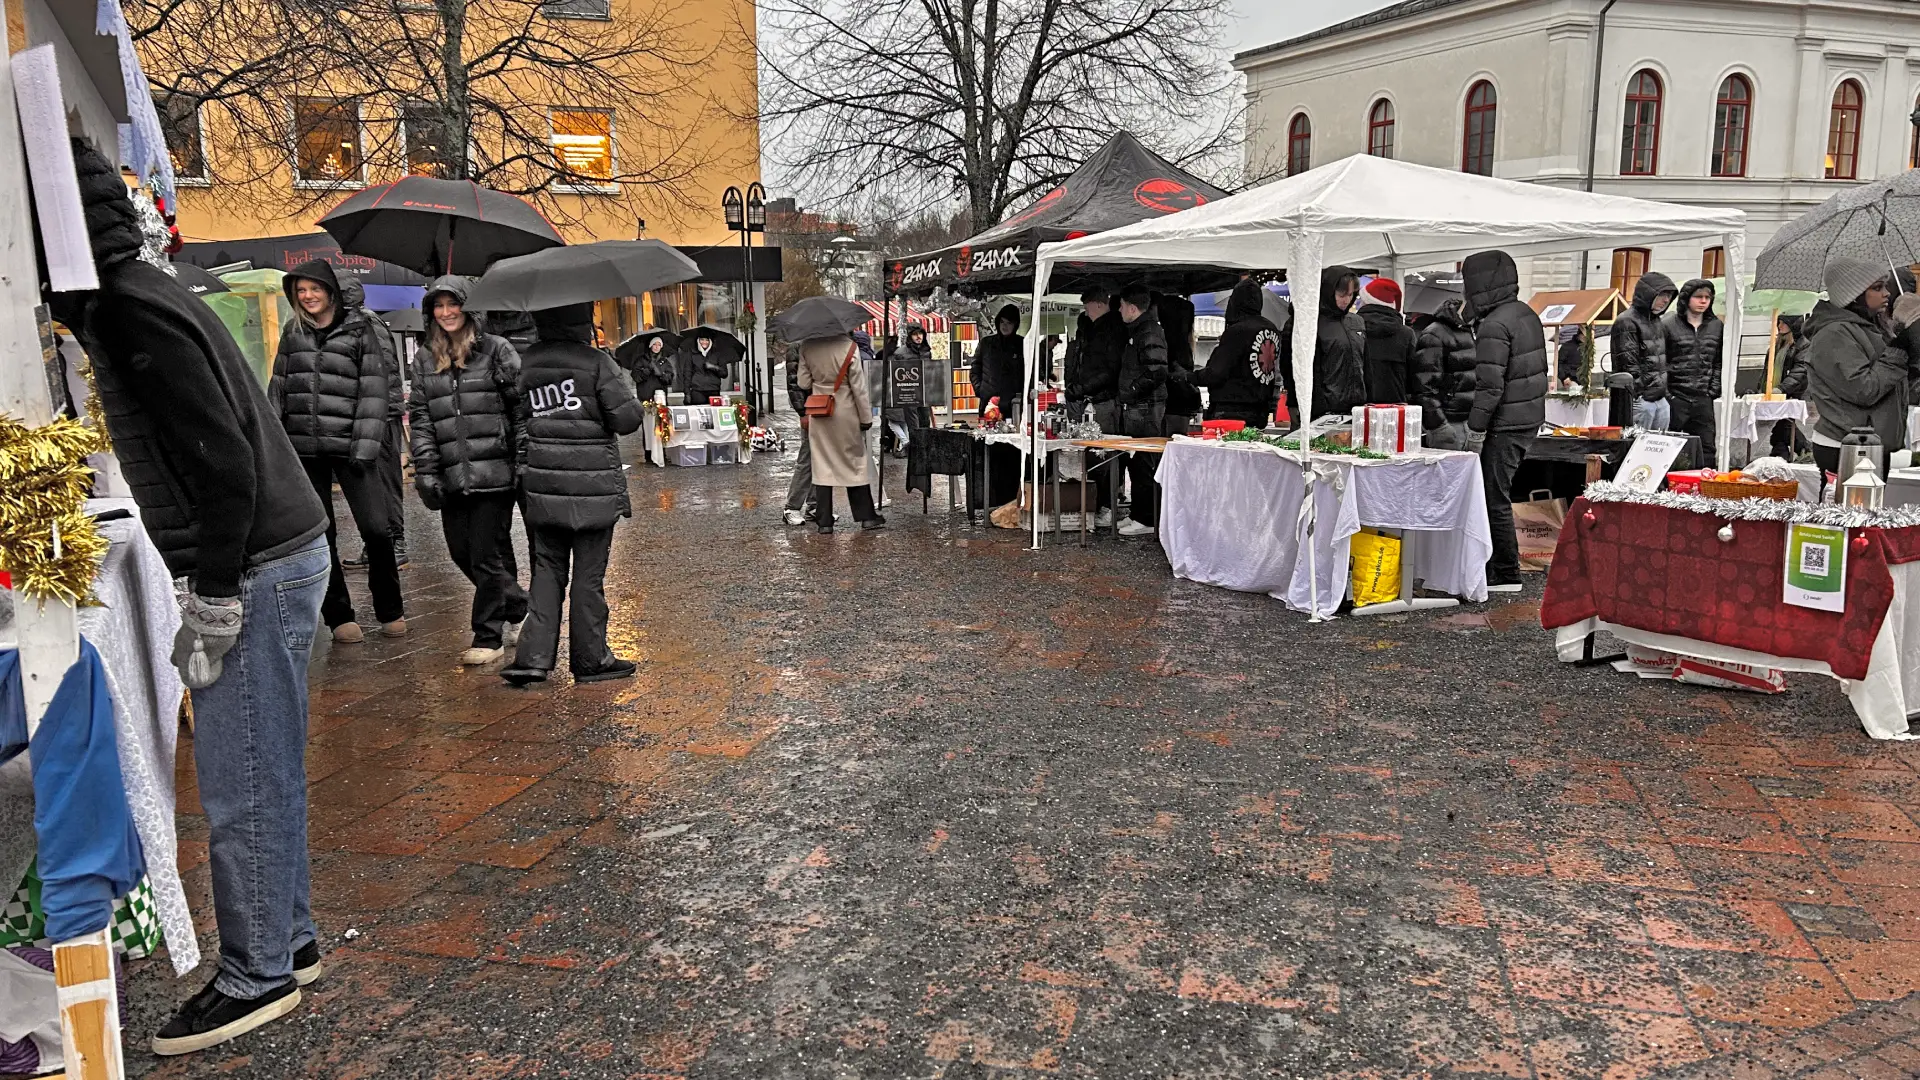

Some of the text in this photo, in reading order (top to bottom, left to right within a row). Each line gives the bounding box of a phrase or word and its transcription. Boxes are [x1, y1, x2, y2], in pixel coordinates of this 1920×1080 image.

[284, 250, 377, 269] Indin Spicy
[903, 257, 942, 284] 24MX
[972, 245, 1022, 272] 24MX
[1252, 330, 1265, 352] HOT
[894, 366, 920, 382] G&S
[1250, 352, 1263, 379] RED
[528, 378, 582, 411] ung
[1371, 546, 1385, 593] www.gekas.se
